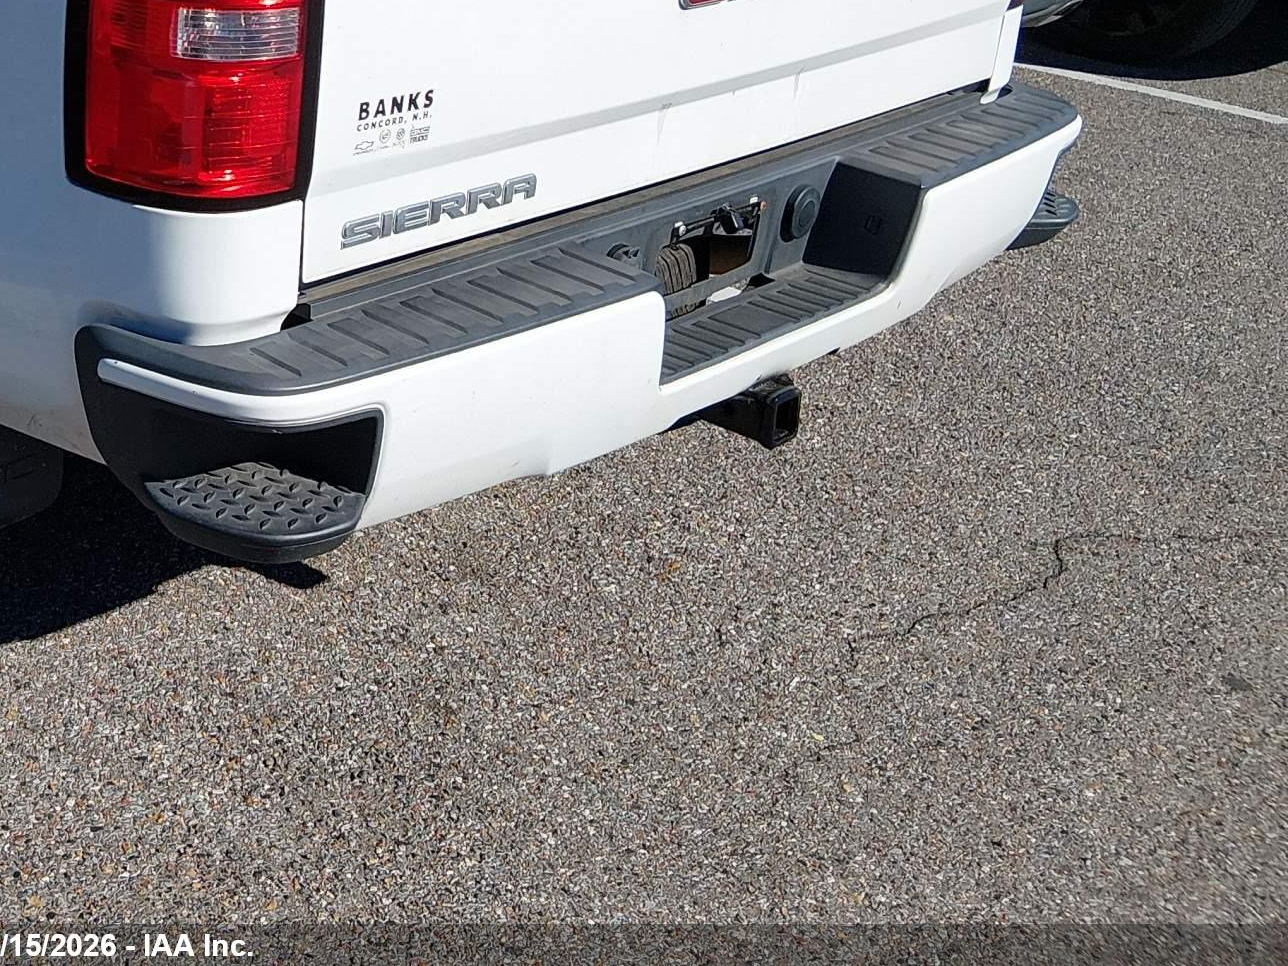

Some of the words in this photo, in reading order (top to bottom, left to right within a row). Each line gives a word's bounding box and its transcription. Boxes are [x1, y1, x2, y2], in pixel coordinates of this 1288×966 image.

[358, 89, 434, 121] BANKS
[356, 116, 408, 132] CONCORD,
[412, 111, 432, 121] N.H.
[340, 172, 537, 250] SIERRA
